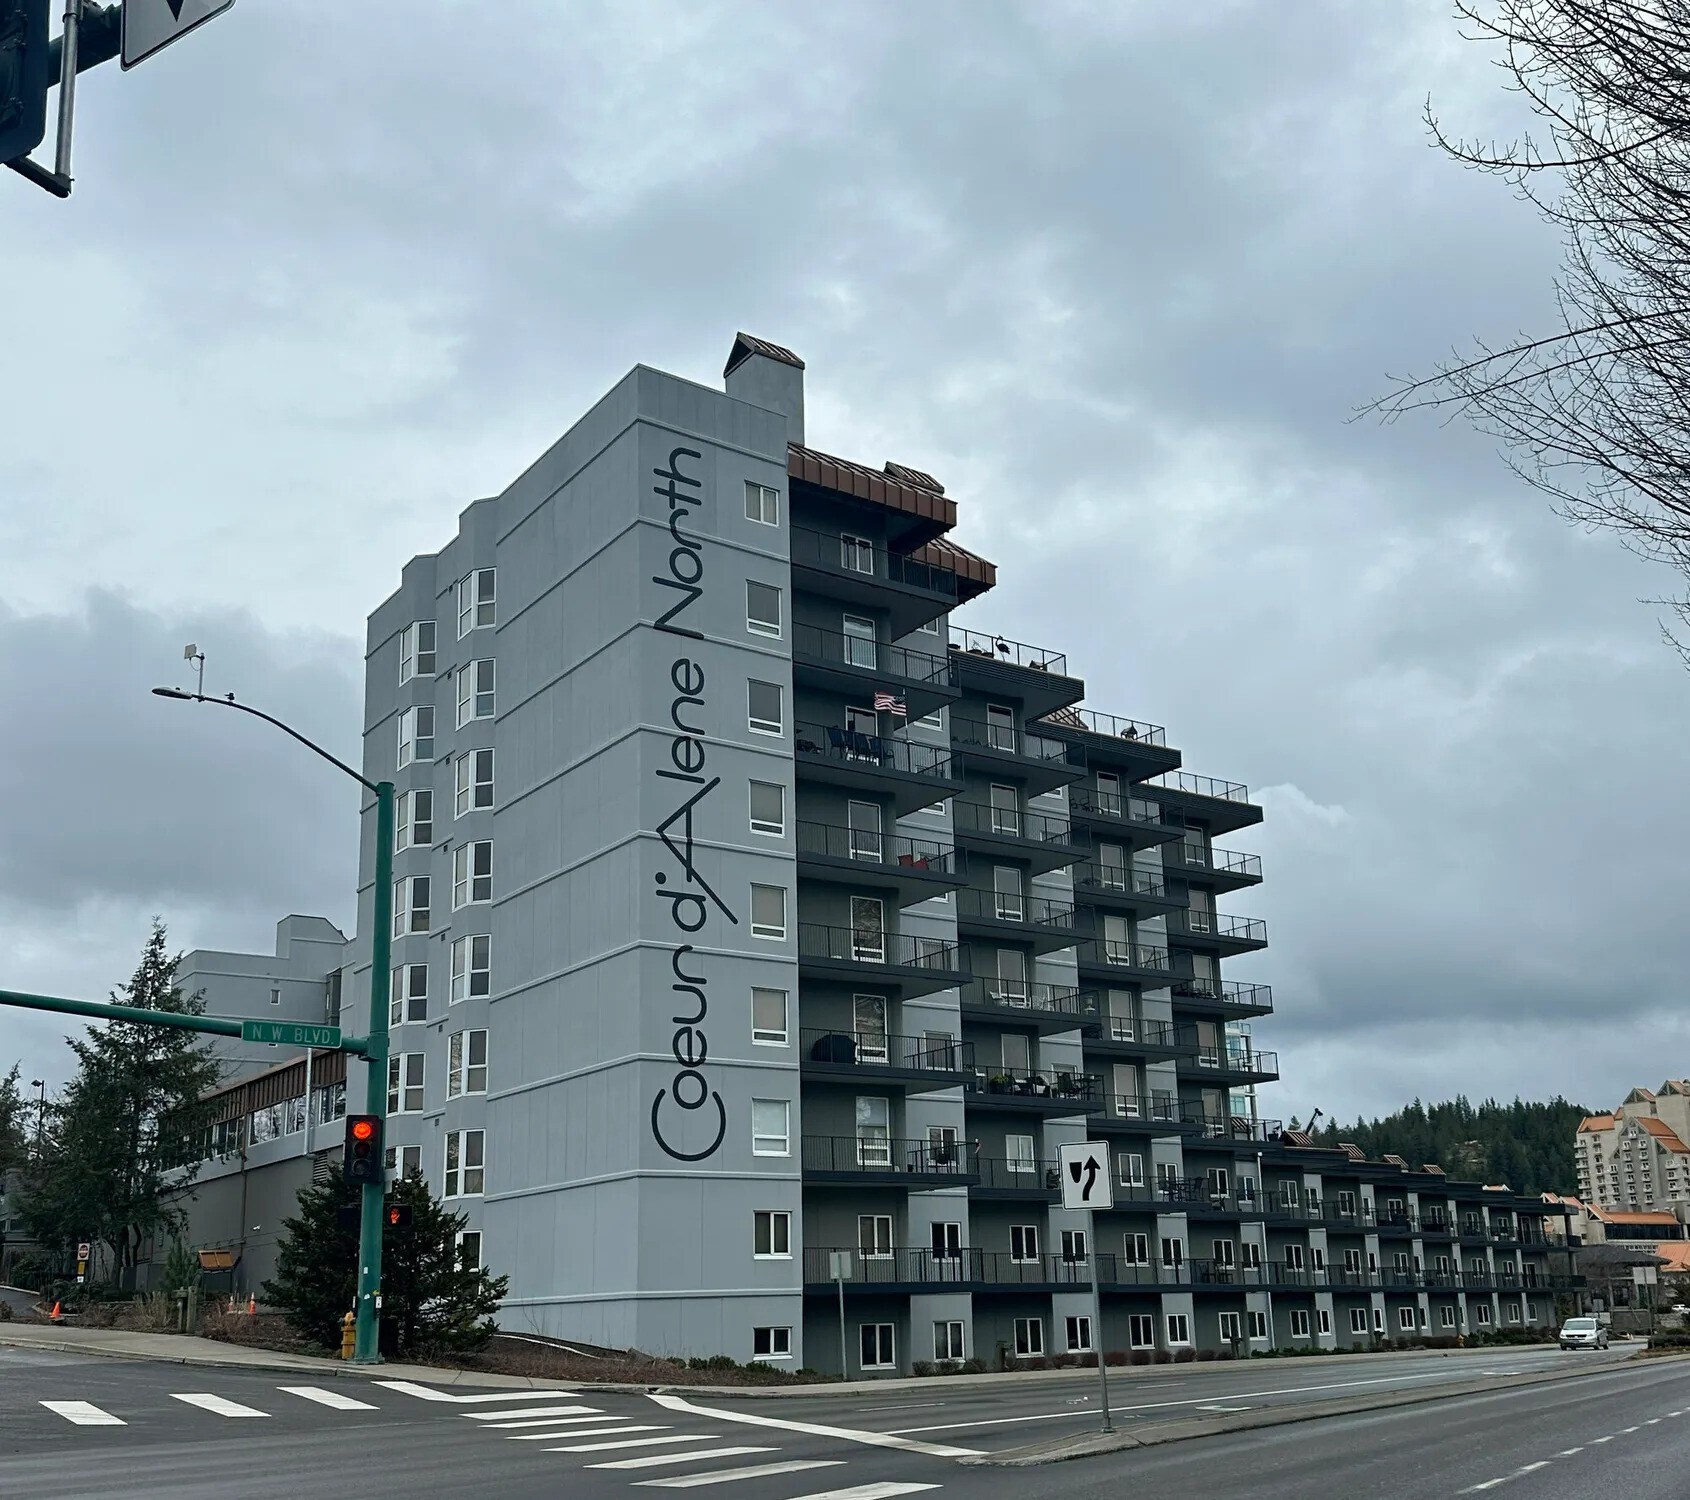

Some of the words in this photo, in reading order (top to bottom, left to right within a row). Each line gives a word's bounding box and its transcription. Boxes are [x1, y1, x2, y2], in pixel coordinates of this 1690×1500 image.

[652, 447, 704, 640] North
[655, 658, 738, 931] d'Alene
[294, 1027, 334, 1045] BLVD.
[652, 945, 726, 1162] Coeur
